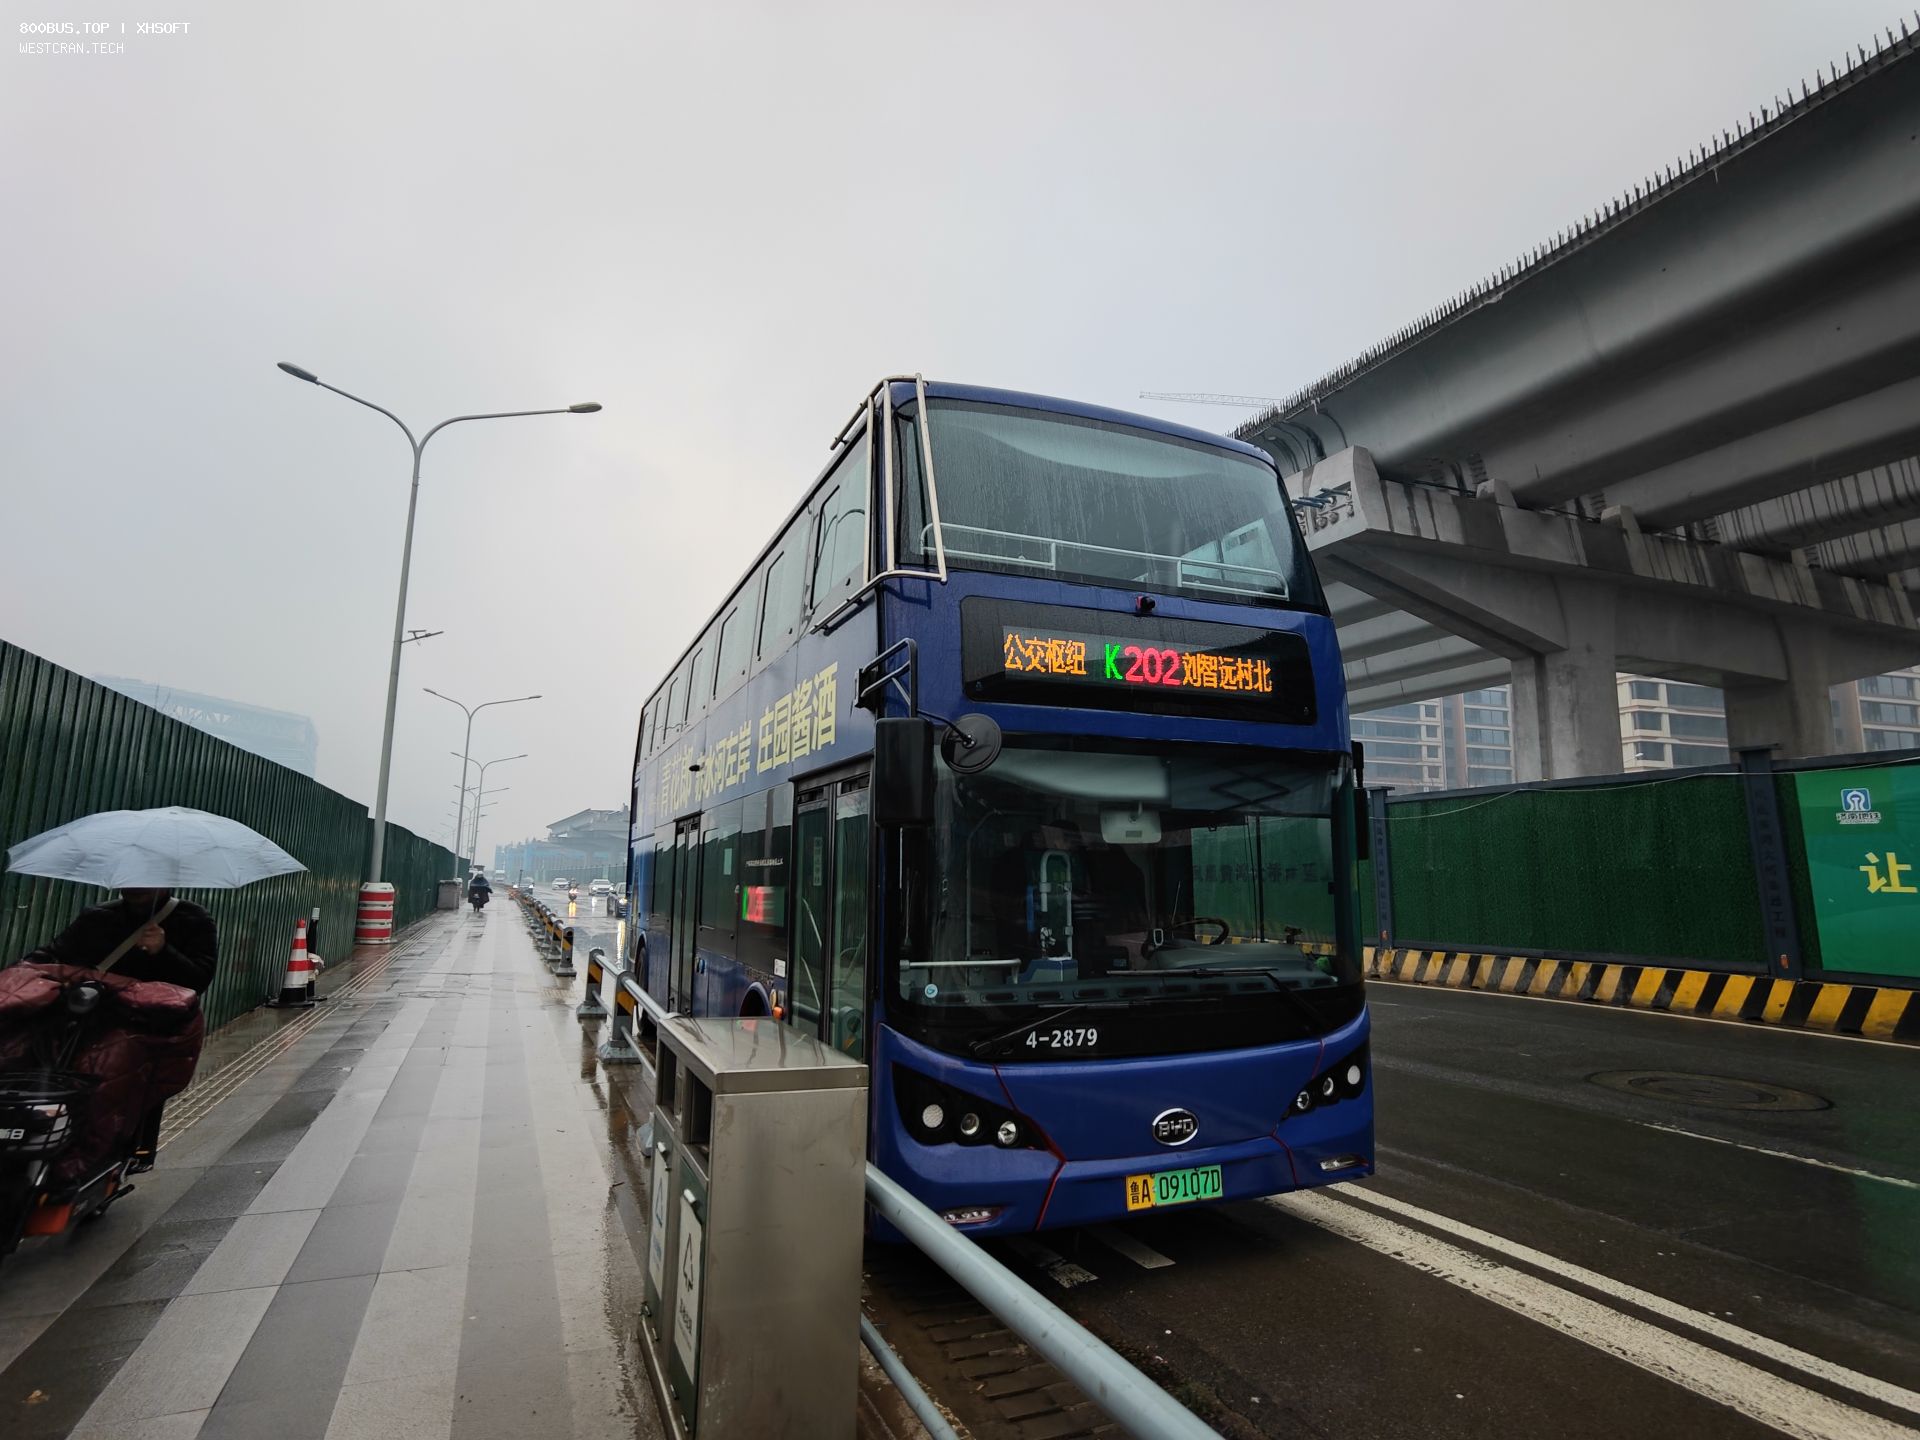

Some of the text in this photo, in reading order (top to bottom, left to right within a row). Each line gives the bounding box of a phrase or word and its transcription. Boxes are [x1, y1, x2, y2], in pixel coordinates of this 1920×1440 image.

[1003, 633, 1273, 693] 公交枢纽 K202 刘智远村北
[1859, 852, 1918, 894] 让
[1025, 1028, 1098, 1049] 4-2879
[1158, 1118, 1194, 1137] BYD
